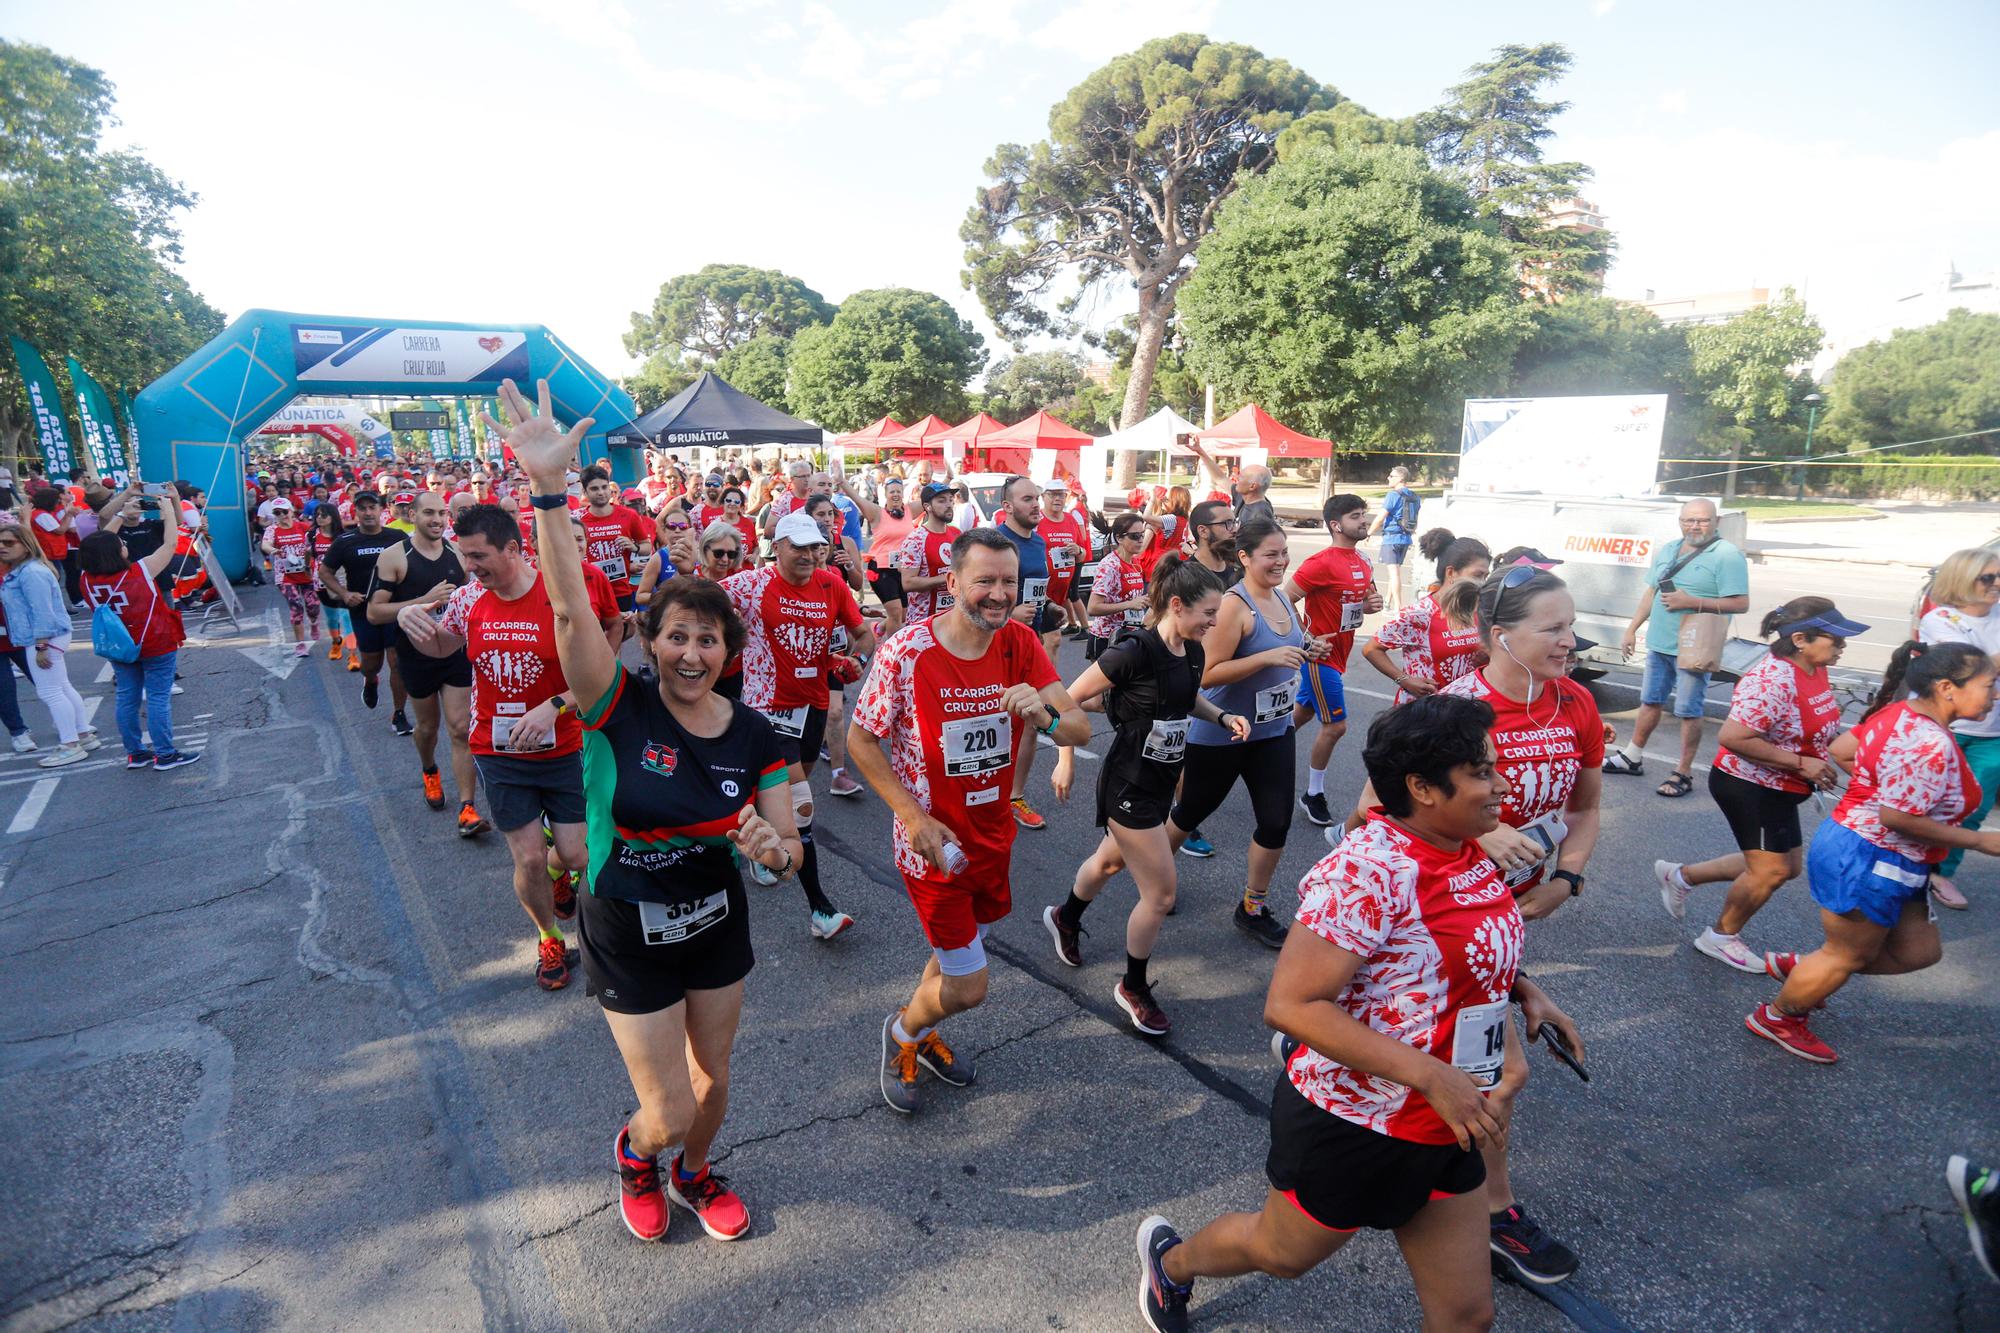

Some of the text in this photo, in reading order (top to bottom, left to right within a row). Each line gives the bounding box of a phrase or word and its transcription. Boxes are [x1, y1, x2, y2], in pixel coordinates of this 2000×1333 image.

[403, 335, 441, 352] CARRERA
[403, 360, 446, 377] CRUZ ROJA
[30, 381, 60, 474] popular
[677, 430, 730, 443] RUNÁTICA
[357, 547, 385, 556] REDO
[1565, 536, 1651, 556] RUNNER'S
[1617, 554, 1645, 564] WORLD
[1033, 585, 1046, 598] 80
[789, 599, 828, 609] CARRERA
[780, 607, 828, 619] CRUZ ROJA
[1350, 608, 1362, 621] 715
[482, 621, 540, 632] IX CARRERA
[483, 632, 538, 643] CRUZ ROJA
[1446, 638, 1466, 648] CRUZ
[939, 687, 952, 698] IX
[1270, 689, 1289, 708] 775
[944, 699, 999, 714] CRUZ ROJ
[963, 728, 997, 753] 220
[1164, 730, 1185, 747] 878
[1496, 726, 1575, 744] IX CARRERA
[1503, 741, 1574, 760] CRUZ ROJA
